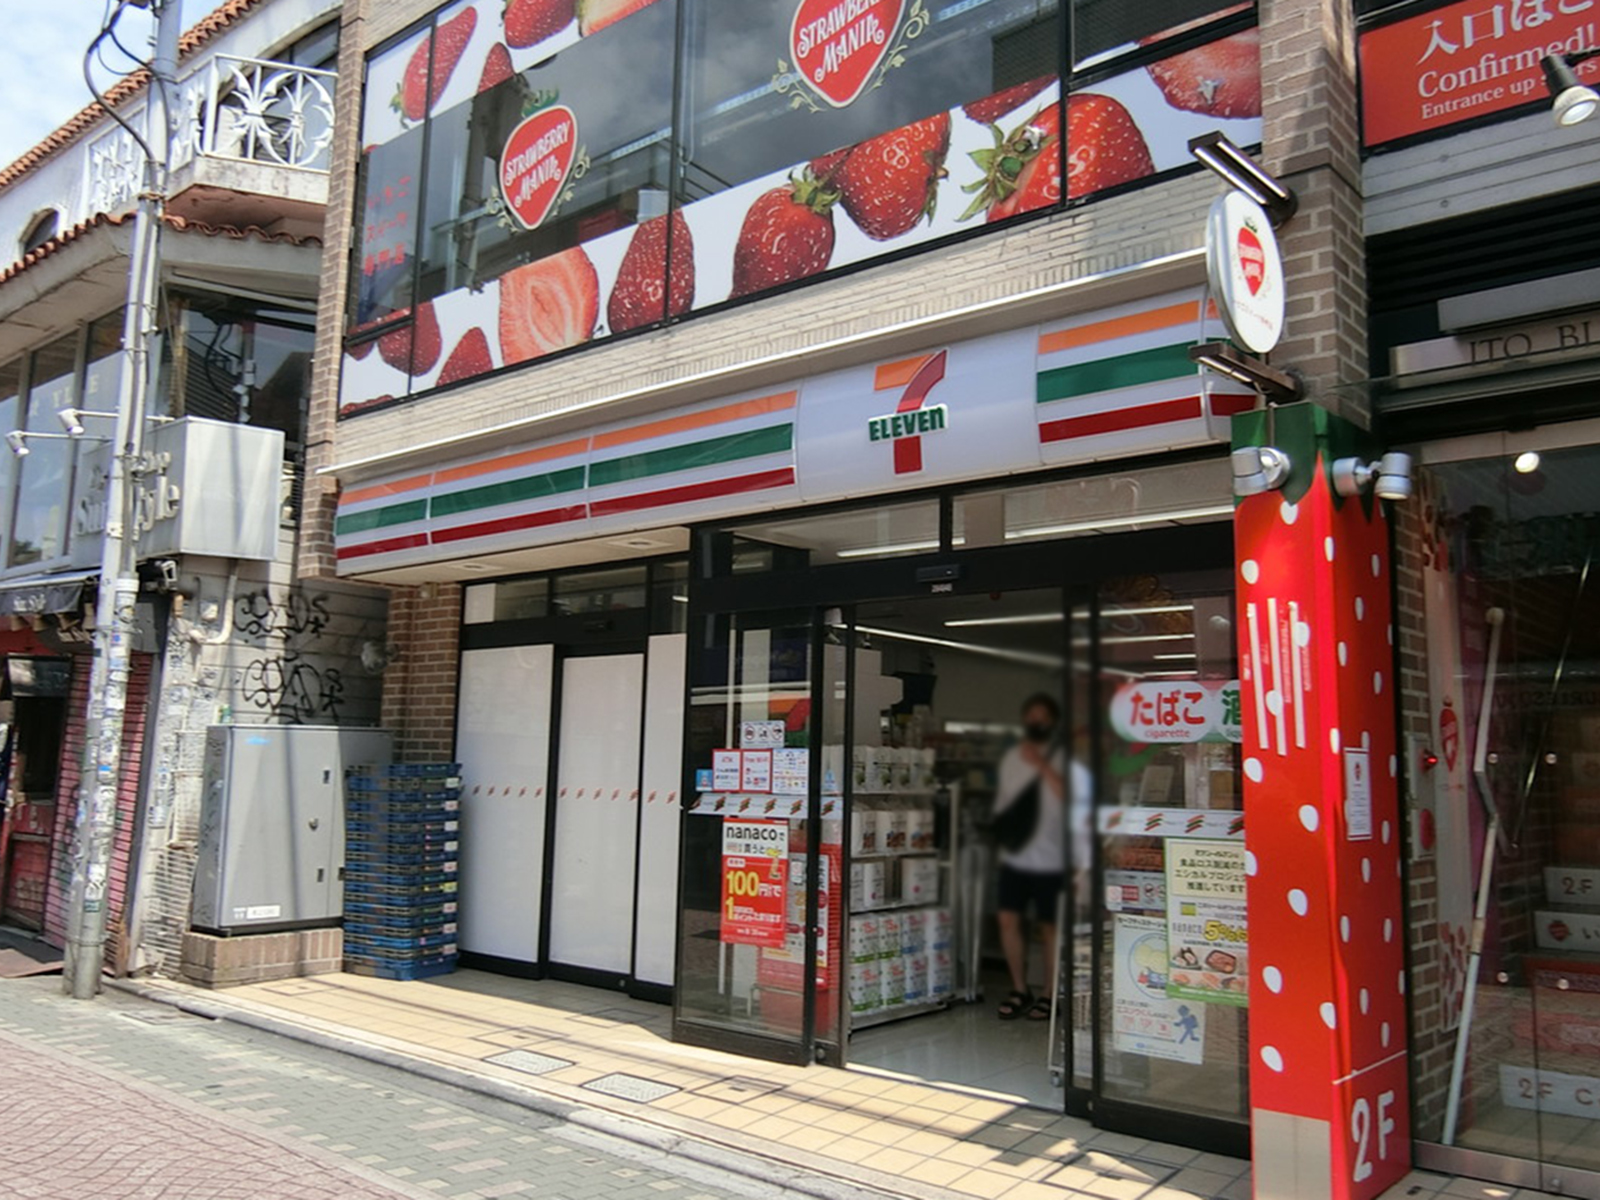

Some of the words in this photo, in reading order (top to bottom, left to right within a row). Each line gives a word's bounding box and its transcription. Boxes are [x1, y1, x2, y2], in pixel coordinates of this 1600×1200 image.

[814, 13, 885, 82] MANIA
[1417, 22, 1597, 98] Confirmed!
[1420, 84, 1505, 120] Entrance
[1509, 77, 1536, 96] up
[505, 120, 571, 187] STRAWBERRY
[514, 154, 562, 208] MANIA
[1130, 689, 1206, 727] たばこ
[726, 826, 778, 841] nanaco
[1518, 1077, 1553, 1100] 2F
[1351, 1090, 1395, 1183] 2F
